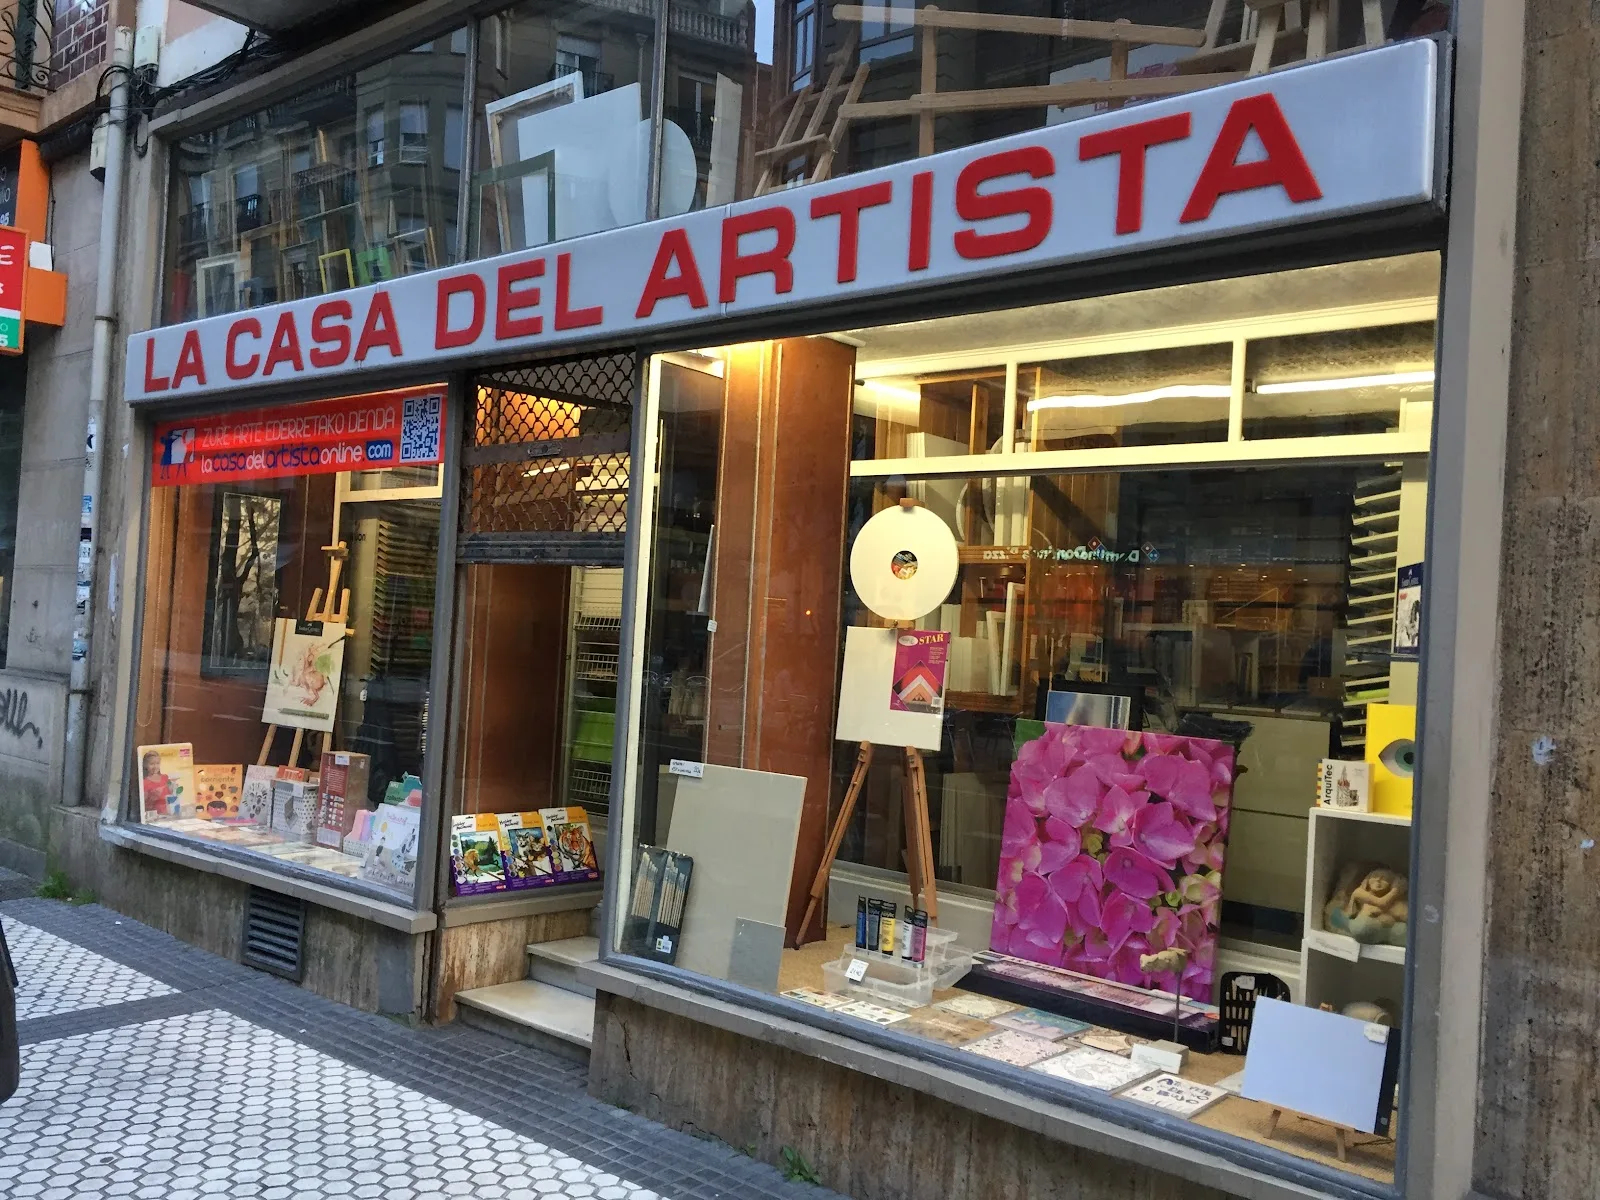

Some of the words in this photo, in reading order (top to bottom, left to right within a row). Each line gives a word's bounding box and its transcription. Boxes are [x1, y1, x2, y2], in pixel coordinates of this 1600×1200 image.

[146, 331, 205, 391] LA
[226, 292, 402, 386] CASA
[435, 253, 603, 349] DEL
[636, 93, 1322, 318] ARTISTA
[202, 425, 231, 448] ZURE
[233, 421, 263, 445] ARTE
[265, 412, 345, 441] EDERRETAKO
[348, 406, 396, 433] DENDA
[918, 633, 945, 646] STAR
[1323, 764, 1334, 806] ArquiTec
